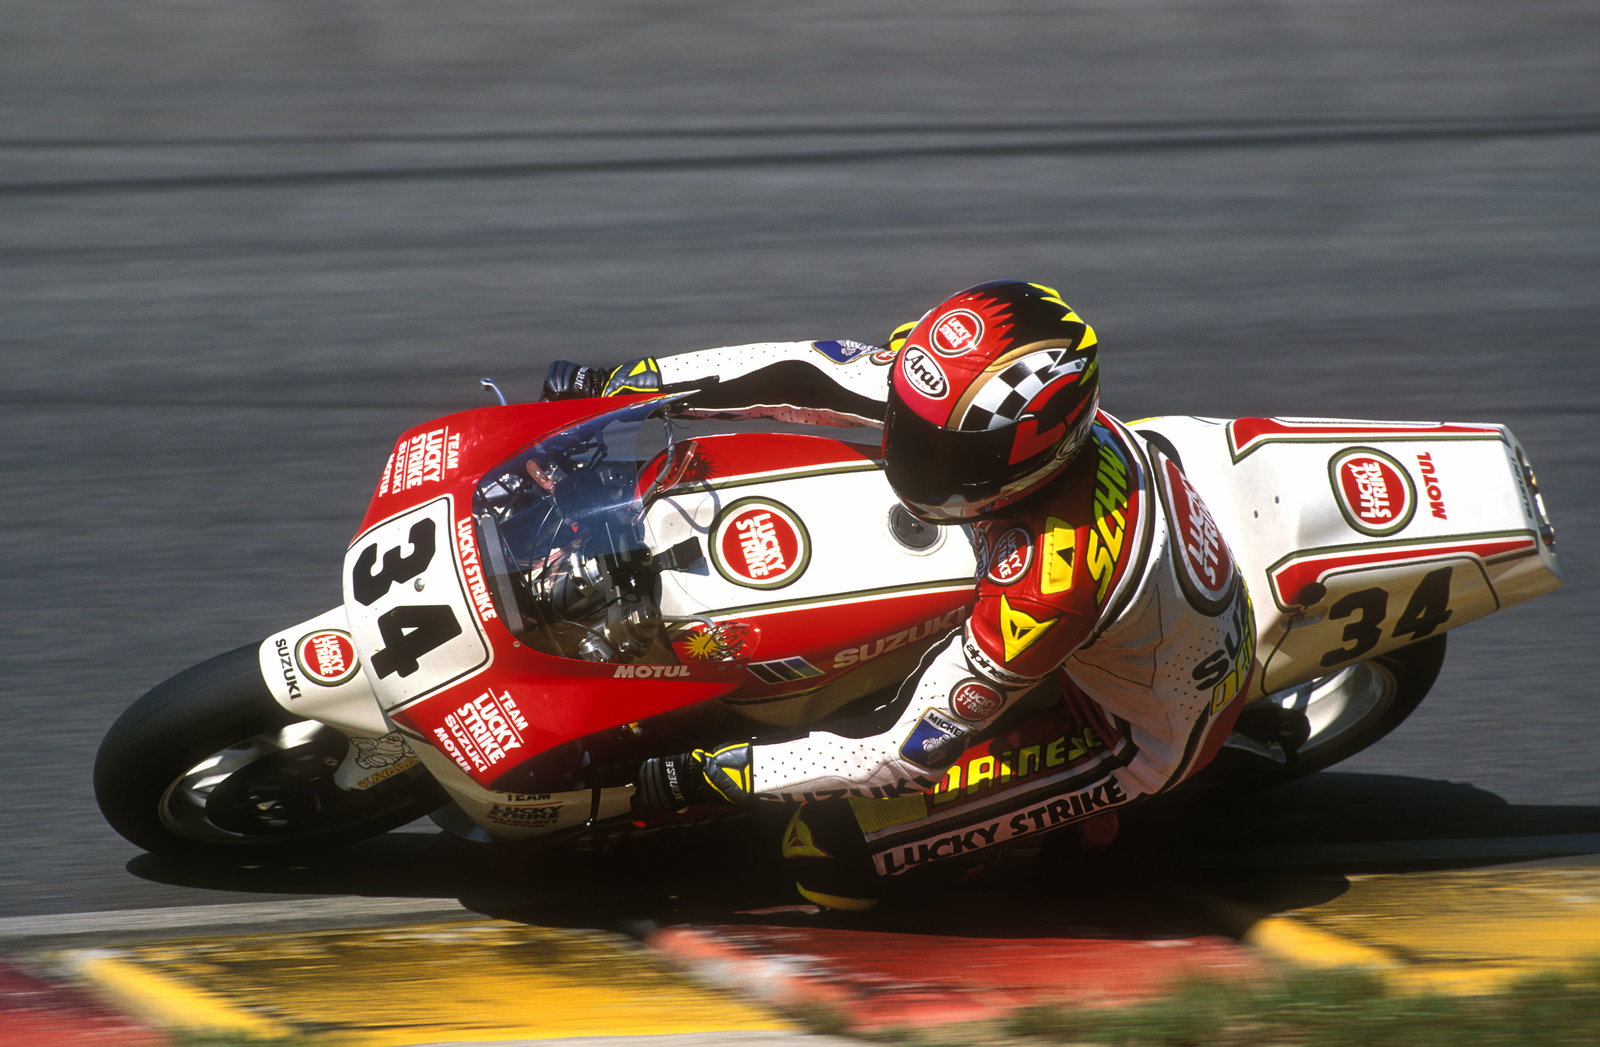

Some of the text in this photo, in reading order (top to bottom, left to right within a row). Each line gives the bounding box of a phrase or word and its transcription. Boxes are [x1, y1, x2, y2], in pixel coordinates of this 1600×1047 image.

[938, 325, 965, 349] STRIKE
[947, 317, 972, 341] LUCKY
[904, 354, 945, 391] Arai
[378, 453, 395, 498] MOTUL
[391, 440, 408, 495] SUZUKI
[406, 433, 427, 490] STRIKE
[423, 428, 444, 482] LUCKY
[446, 433, 460, 469] TEAM
[1347, 462, 1376, 519] LUCKY
[1365, 461, 1393, 519] STRIKE
[1416, 452, 1448, 521] MOTUL
[457, 517, 498, 622] LUCKY STRIKE
[735, 520, 770, 579] STRIKE
[752, 512, 787, 572] LUCKY
[352, 517, 463, 680] 34
[1320, 565, 1454, 668] 34
[312, 637, 334, 676] STRIKE
[326, 635, 346, 673] LUCKY
[833, 605, 966, 670] SUZUKI
[275, 638, 303, 701] SUZUKI
[613, 664, 691, 679] MOTUL
[963, 686, 997, 708] LUCKY
[472, 692, 522, 752] LUCKY
[499, 690, 529, 731] TEAM
[928, 712, 964, 738] MICHE
[957, 693, 992, 715] STRIKE
[433, 727, 473, 774] MOTUL
[444, 714, 488, 772] SUZUKI
[456, 702, 507, 766] STRIKE
[934, 727, 1103, 804] DAINESE
[883, 775, 1127, 875] LUCKY STRIKE
